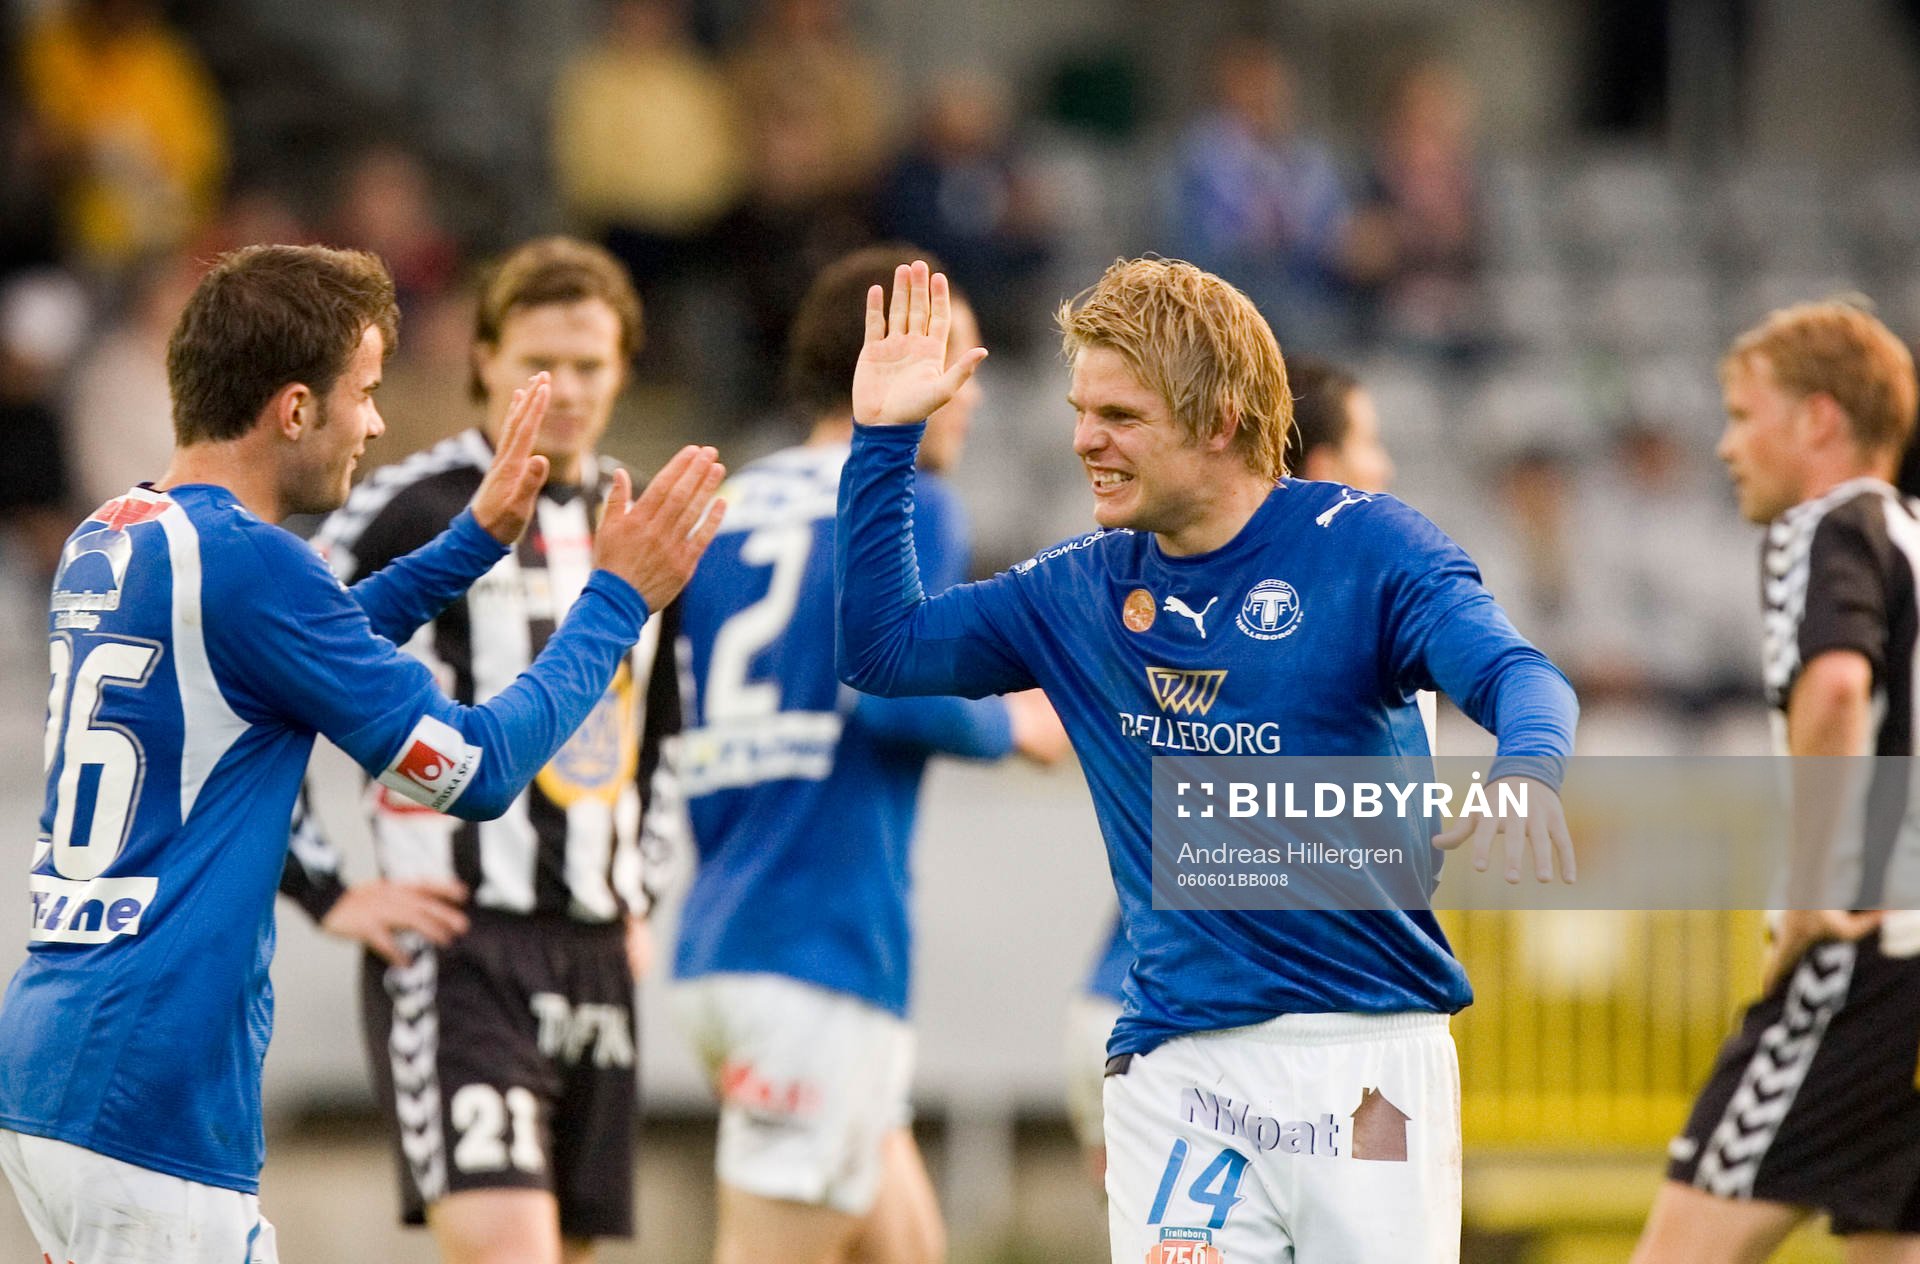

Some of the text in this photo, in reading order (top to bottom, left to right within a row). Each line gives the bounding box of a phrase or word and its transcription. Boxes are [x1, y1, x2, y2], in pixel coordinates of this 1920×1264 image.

[450, 1083, 545, 1174] 21
[1147, 1138, 1252, 1230] 14
[1164, 1228, 1207, 1241] Trelleborg
